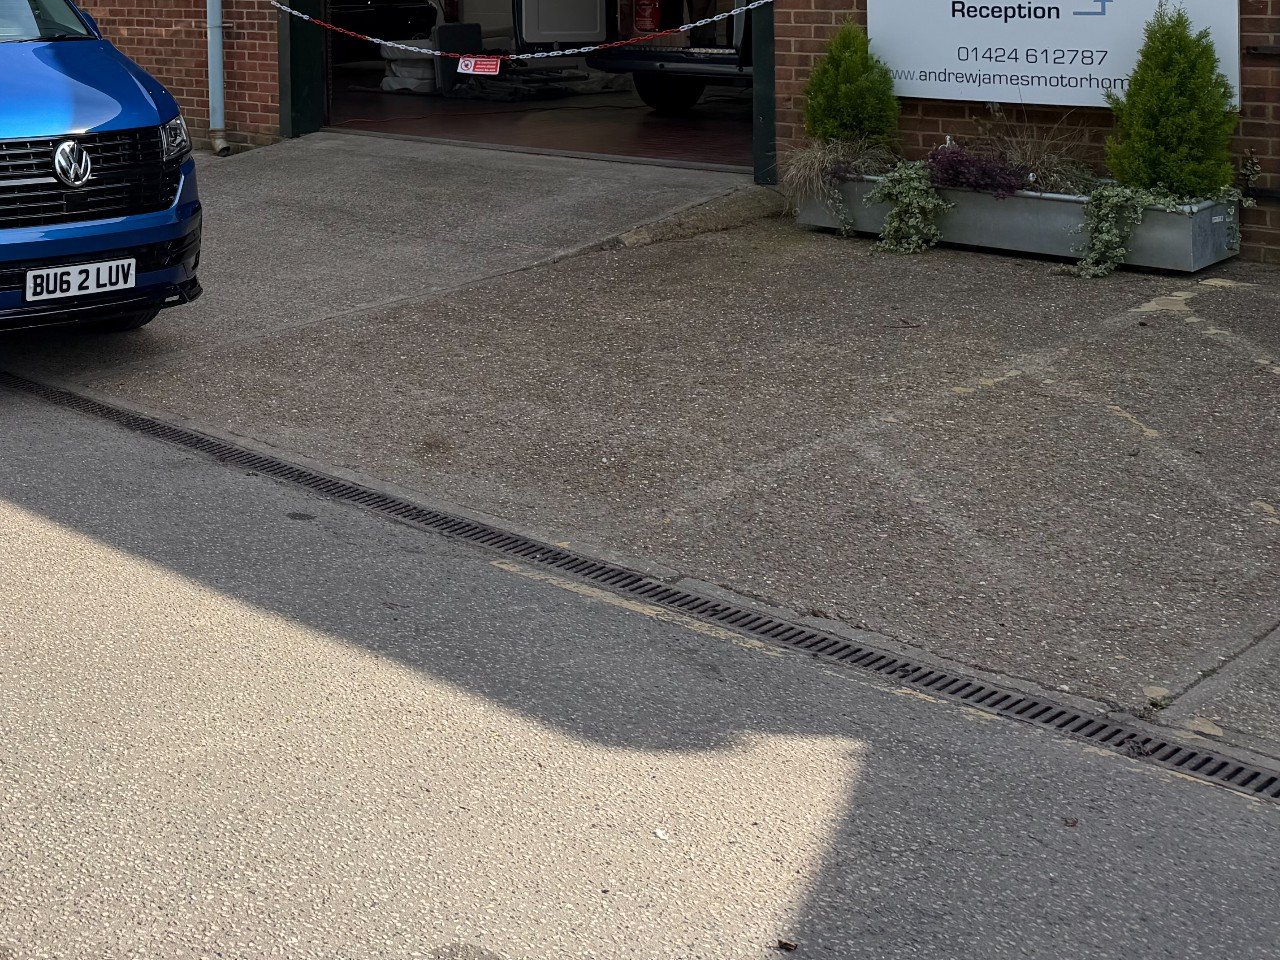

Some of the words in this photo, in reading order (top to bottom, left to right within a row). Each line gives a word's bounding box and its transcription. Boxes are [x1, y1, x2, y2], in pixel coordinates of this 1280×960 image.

[951, 0, 1061, 23] Reception
[957, 46, 1020, 63] 01424
[1025, 48, 1109, 66] 612787
[32, 271, 71, 297] BU6
[77, 269, 90, 291] 2
[96, 263, 132, 289] LUV
